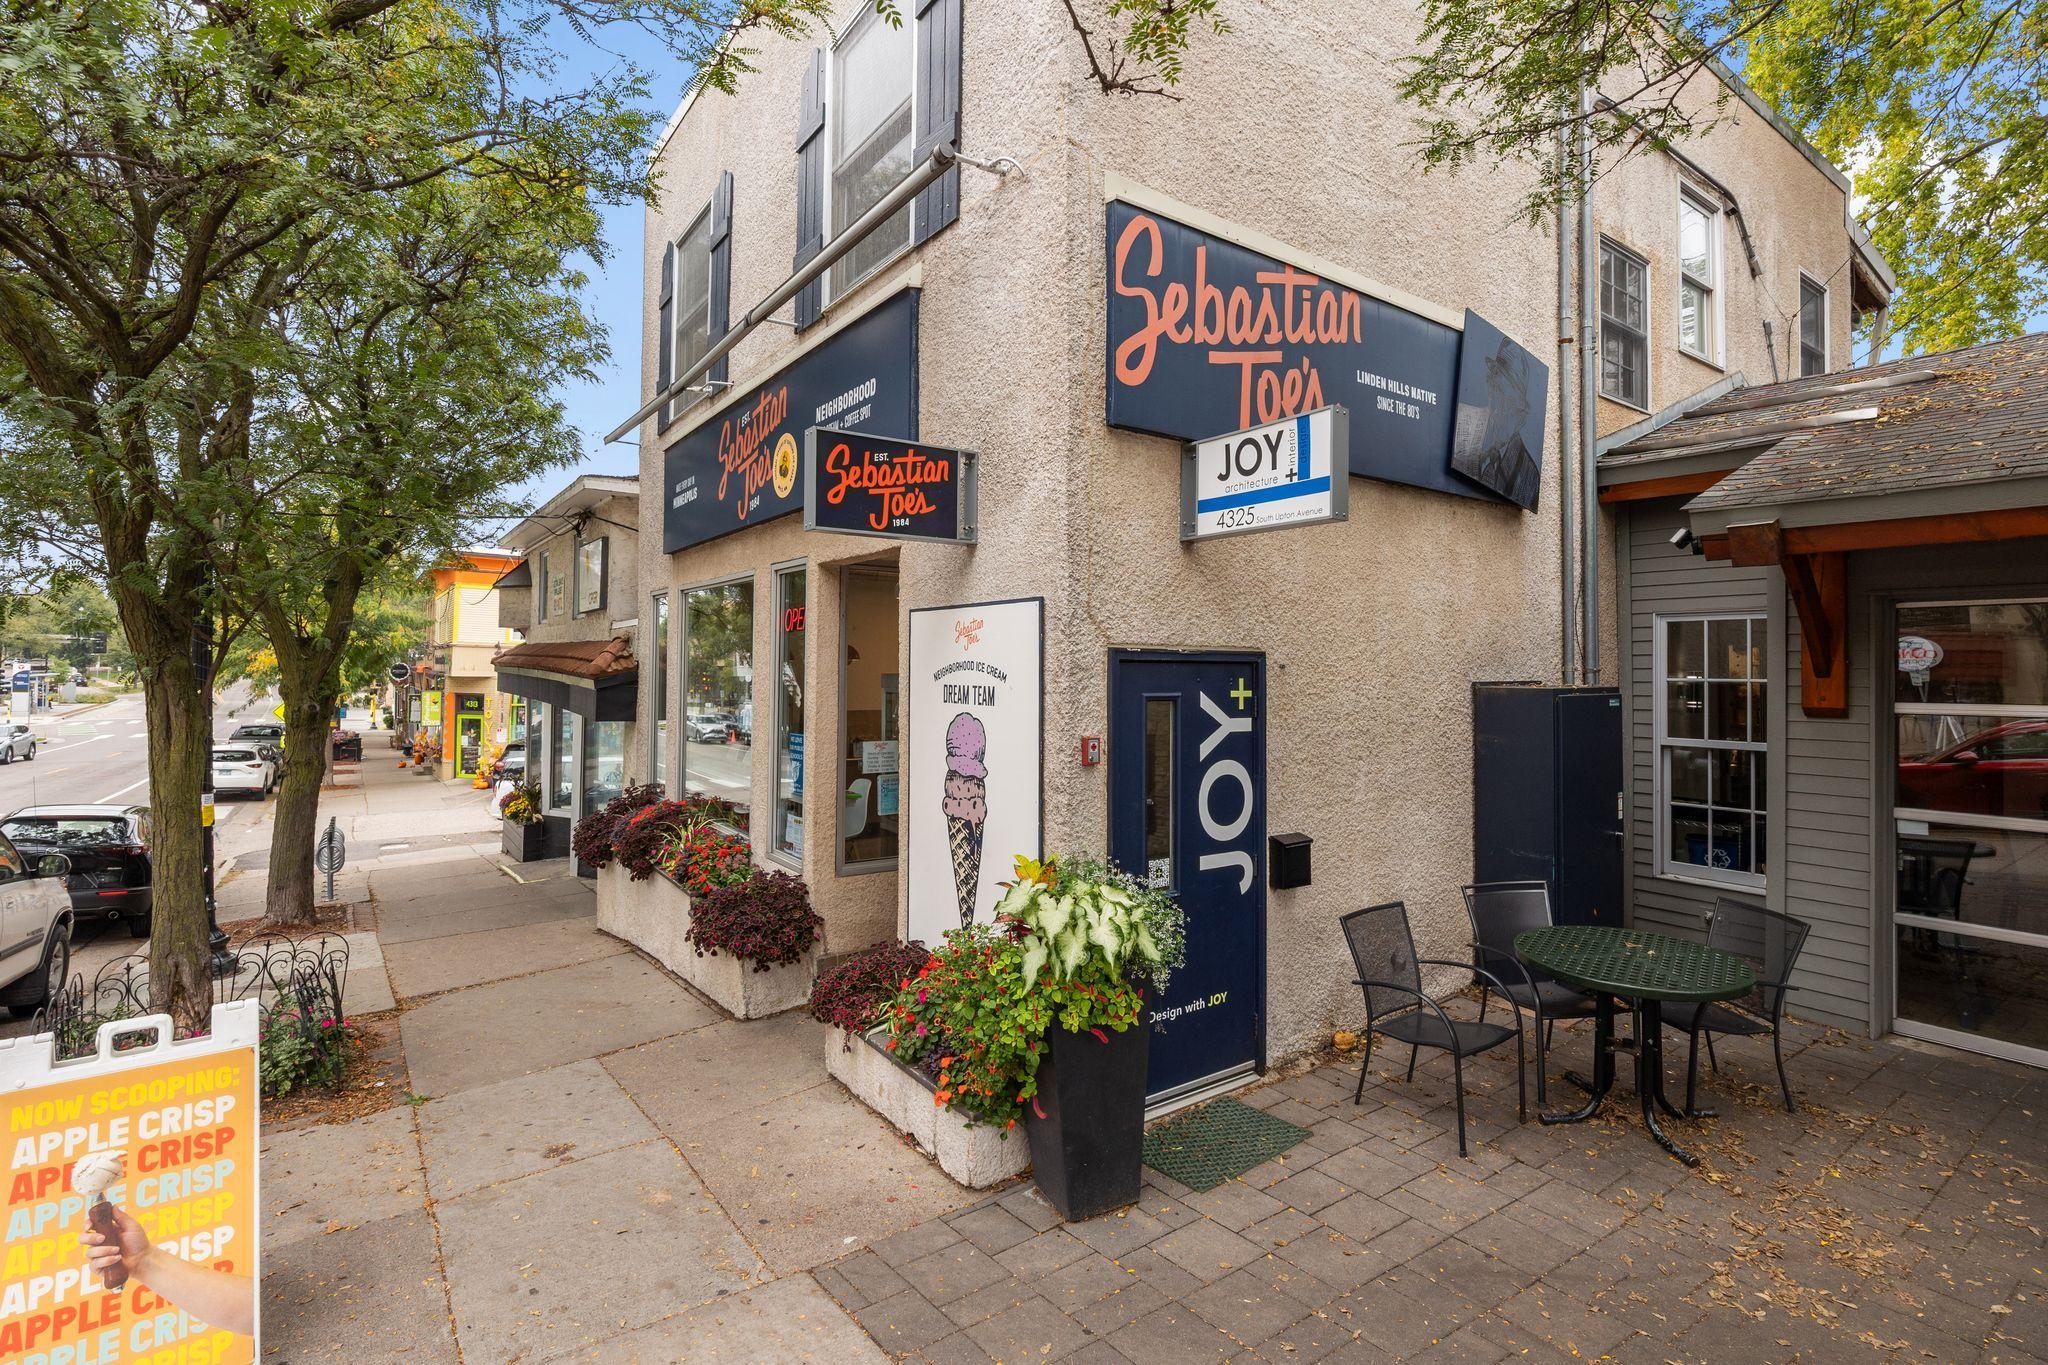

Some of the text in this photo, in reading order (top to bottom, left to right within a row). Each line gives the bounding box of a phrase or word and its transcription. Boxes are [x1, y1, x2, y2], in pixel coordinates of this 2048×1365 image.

[1115, 215, 1361, 386] Sebastian
[815, 377, 877, 424] NEIGHBORHOOD
[1208, 350, 1325, 430] Joe's
[1356, 370, 1437, 405] LINDEN HILLS NATIVE
[1376, 395, 1420, 420] SINCE THE 80'S
[844, 409, 860, 428] COFFEE
[859, 403, 872, 421] SPOT
[718, 386, 788, 501] Sebastian
[874, 453, 889, 462] EST.
[1217, 430, 1284, 481] JOY
[1288, 427, 1297, 467] interior
[737, 444, 773, 520] Joe's
[825, 443, 949, 505] Sebastian
[1224, 476, 1279, 494] architecture
[868, 487, 936, 530] Joe's
[892, 518, 910, 527] 1984
[1217, 506, 1323, 528] 4325 South Upton Avenue
[785, 607, 805, 632] OPE
[955, 617, 984, 644] Sebastian
[933, 660, 1008, 683] NEIGHBORHOOD ICE CREAM
[943, 684, 995, 706] DREAM TEAM
[1185, 997, 1205, 1013] with
[1207, 991, 1228, 1007] JOY
[10, 1066, 241, 1132] NOW SCOOPING:
[11, 1095, 236, 1169] APPLE CRISP
[137, 1126, 235, 1173] CRISP
[135, 1158, 235, 1208] CRISP
[0, 1264, 106, 1320] APPL
[0, 1293, 122, 1357] APPLE
